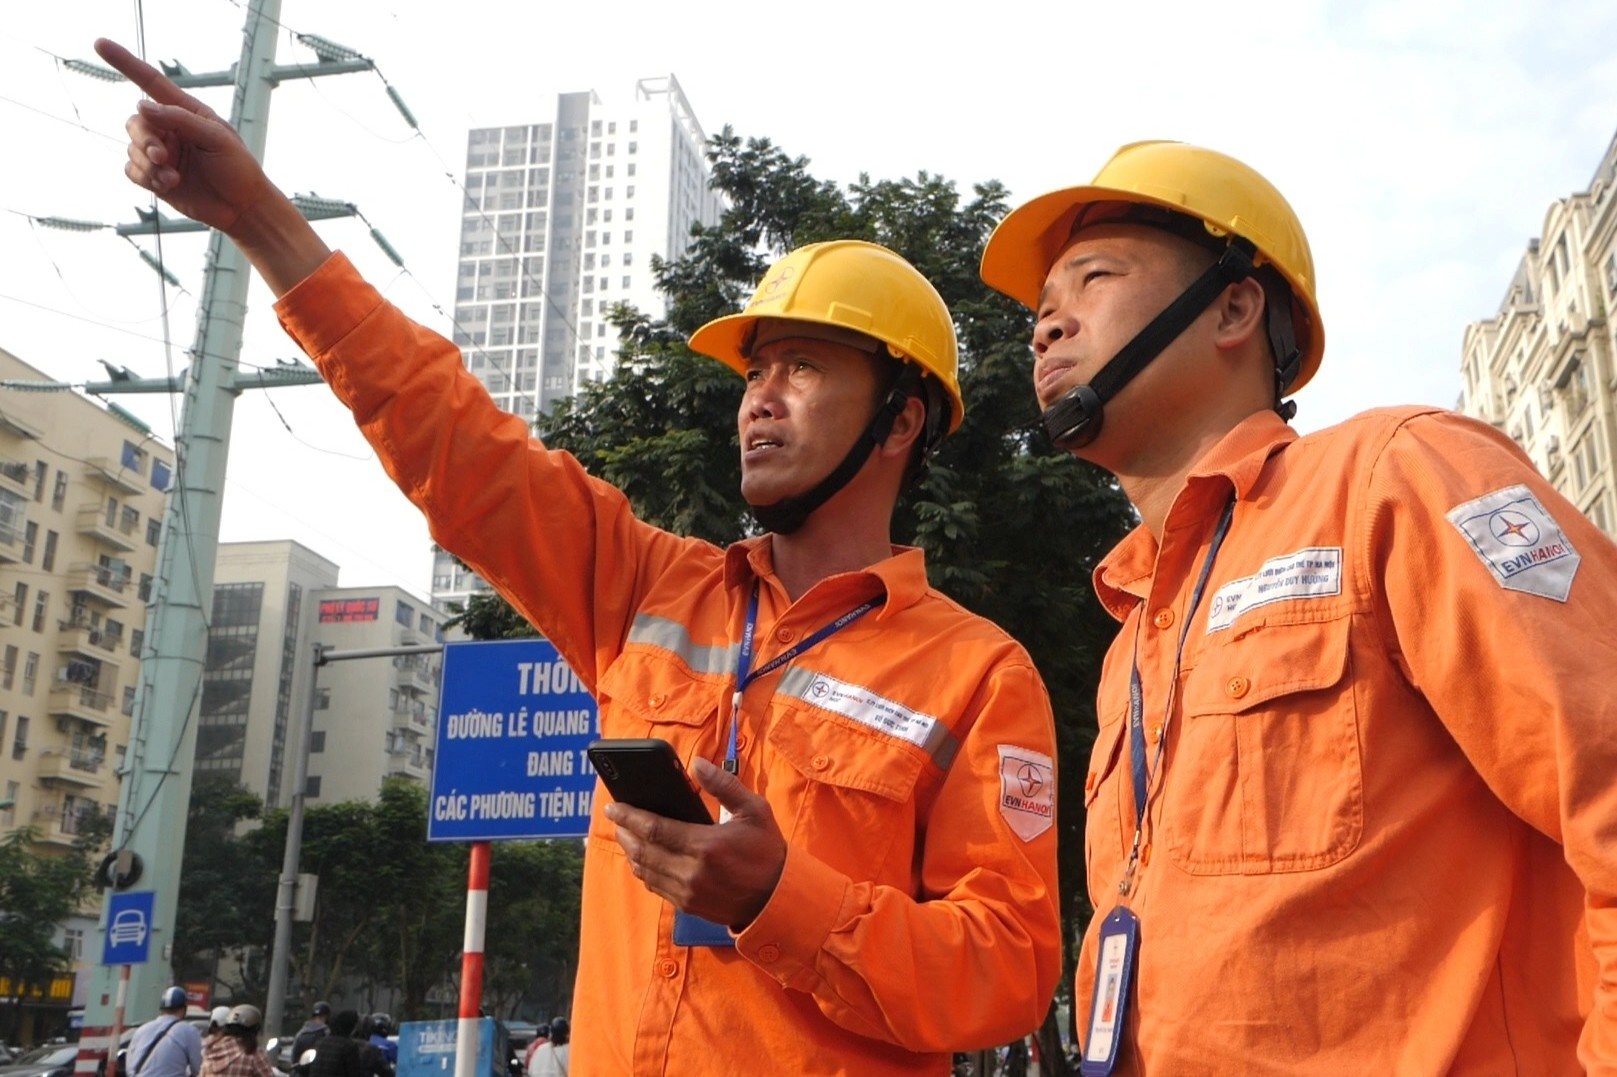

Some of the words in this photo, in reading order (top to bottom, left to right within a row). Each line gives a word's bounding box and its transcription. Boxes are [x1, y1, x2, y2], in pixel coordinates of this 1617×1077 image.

[1501, 544, 1566, 573] EVNHANOI
[741, 622, 753, 657] EVNHANOI
[447, 708, 503, 740] ĐƯỜNG
[508, 707, 528, 737] LÊ
[533, 710, 590, 738] QUANG
[527, 751, 573, 777] ĐANG
[435, 788, 467, 821] CÁC
[470, 790, 535, 820] PHƯƠNG
[540, 787, 574, 822] TIỆN
[1005, 795, 1050, 814] EVNHANOI
